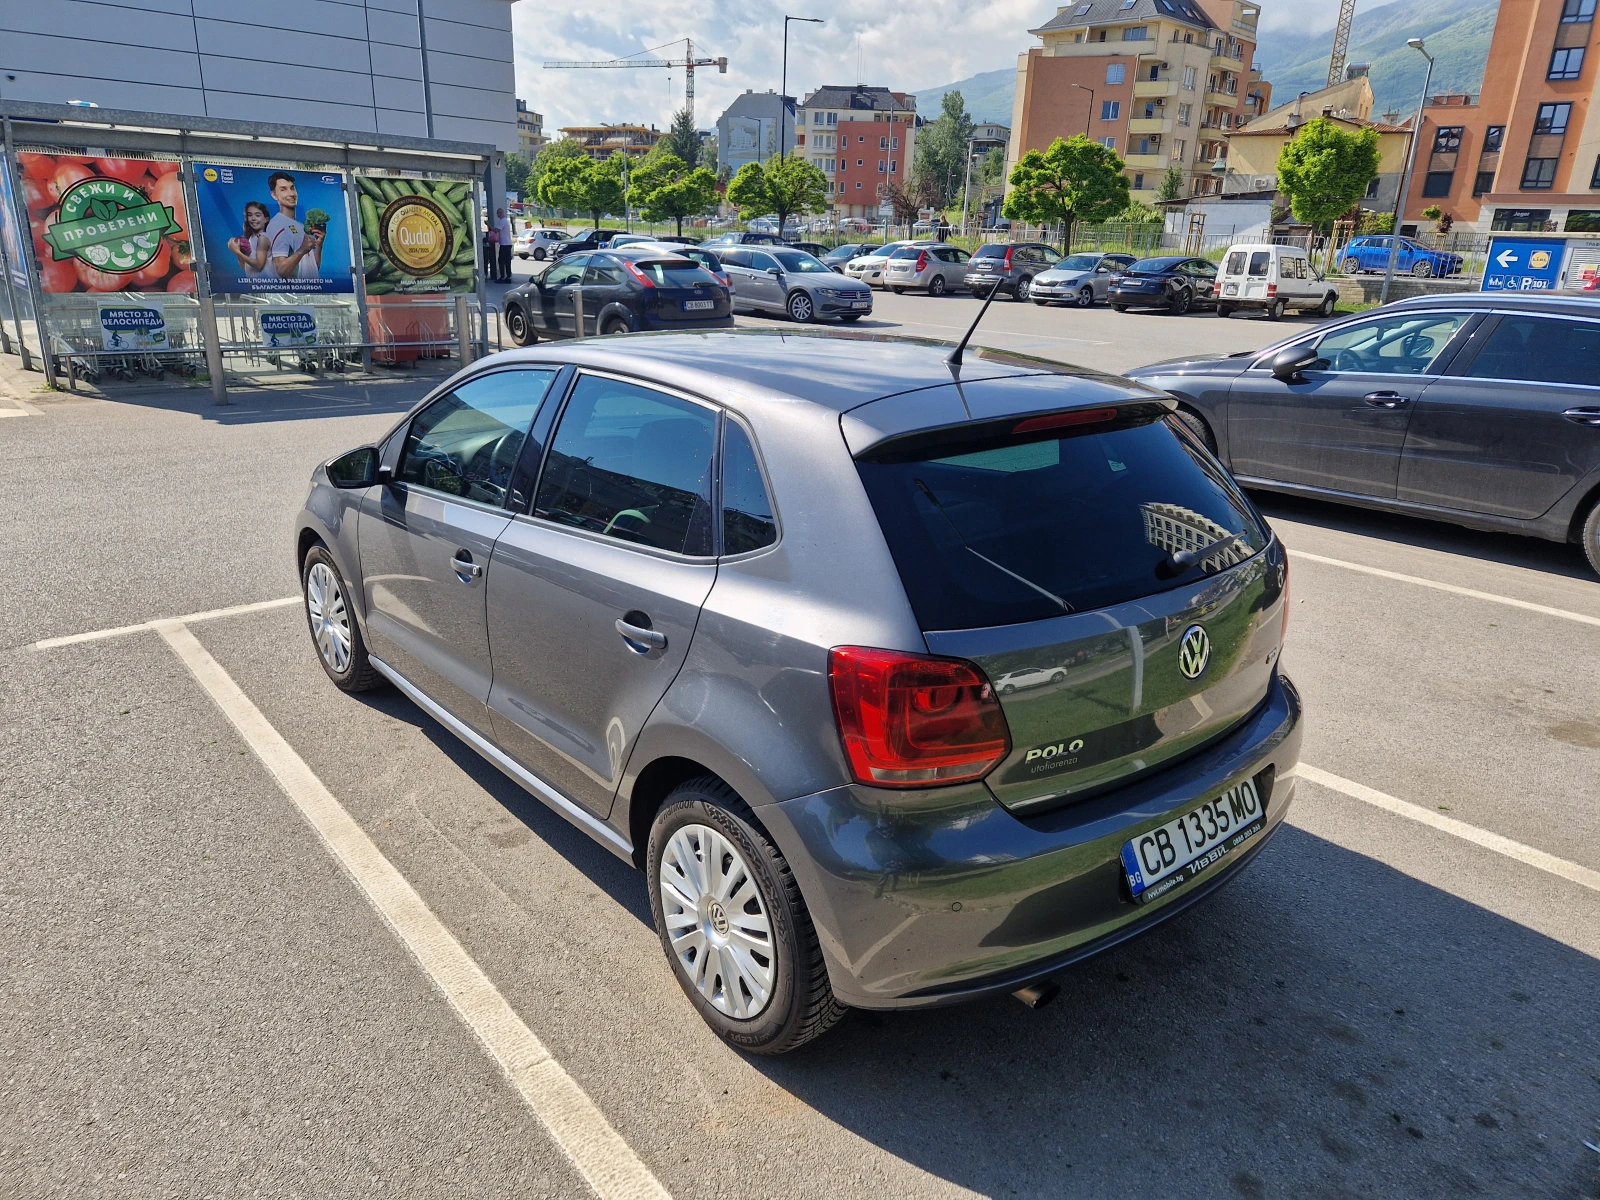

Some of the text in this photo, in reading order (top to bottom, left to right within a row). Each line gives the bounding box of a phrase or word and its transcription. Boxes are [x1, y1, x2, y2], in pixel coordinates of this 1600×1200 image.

[66, 183, 135, 213] СВЕЖИ И
[63, 211, 158, 242] ПРОВЕРЕНИ
[391, 213, 401, 226] TOP
[400, 206, 422, 216] QUALITY
[423, 210, 439, 227] MEDAL
[400, 226, 434, 246] Qudal
[1533, 280, 1547, 288] 101
[101, 318, 163, 326] ВЕЛОСИПЕДИ
[262, 322, 314, 330] ВЕЛОСИПЕДИ
[1025, 739, 1084, 764] POLO
[1139, 781, 1257, 876] CB 1335 MO
[1129, 871, 1142, 887] BG
